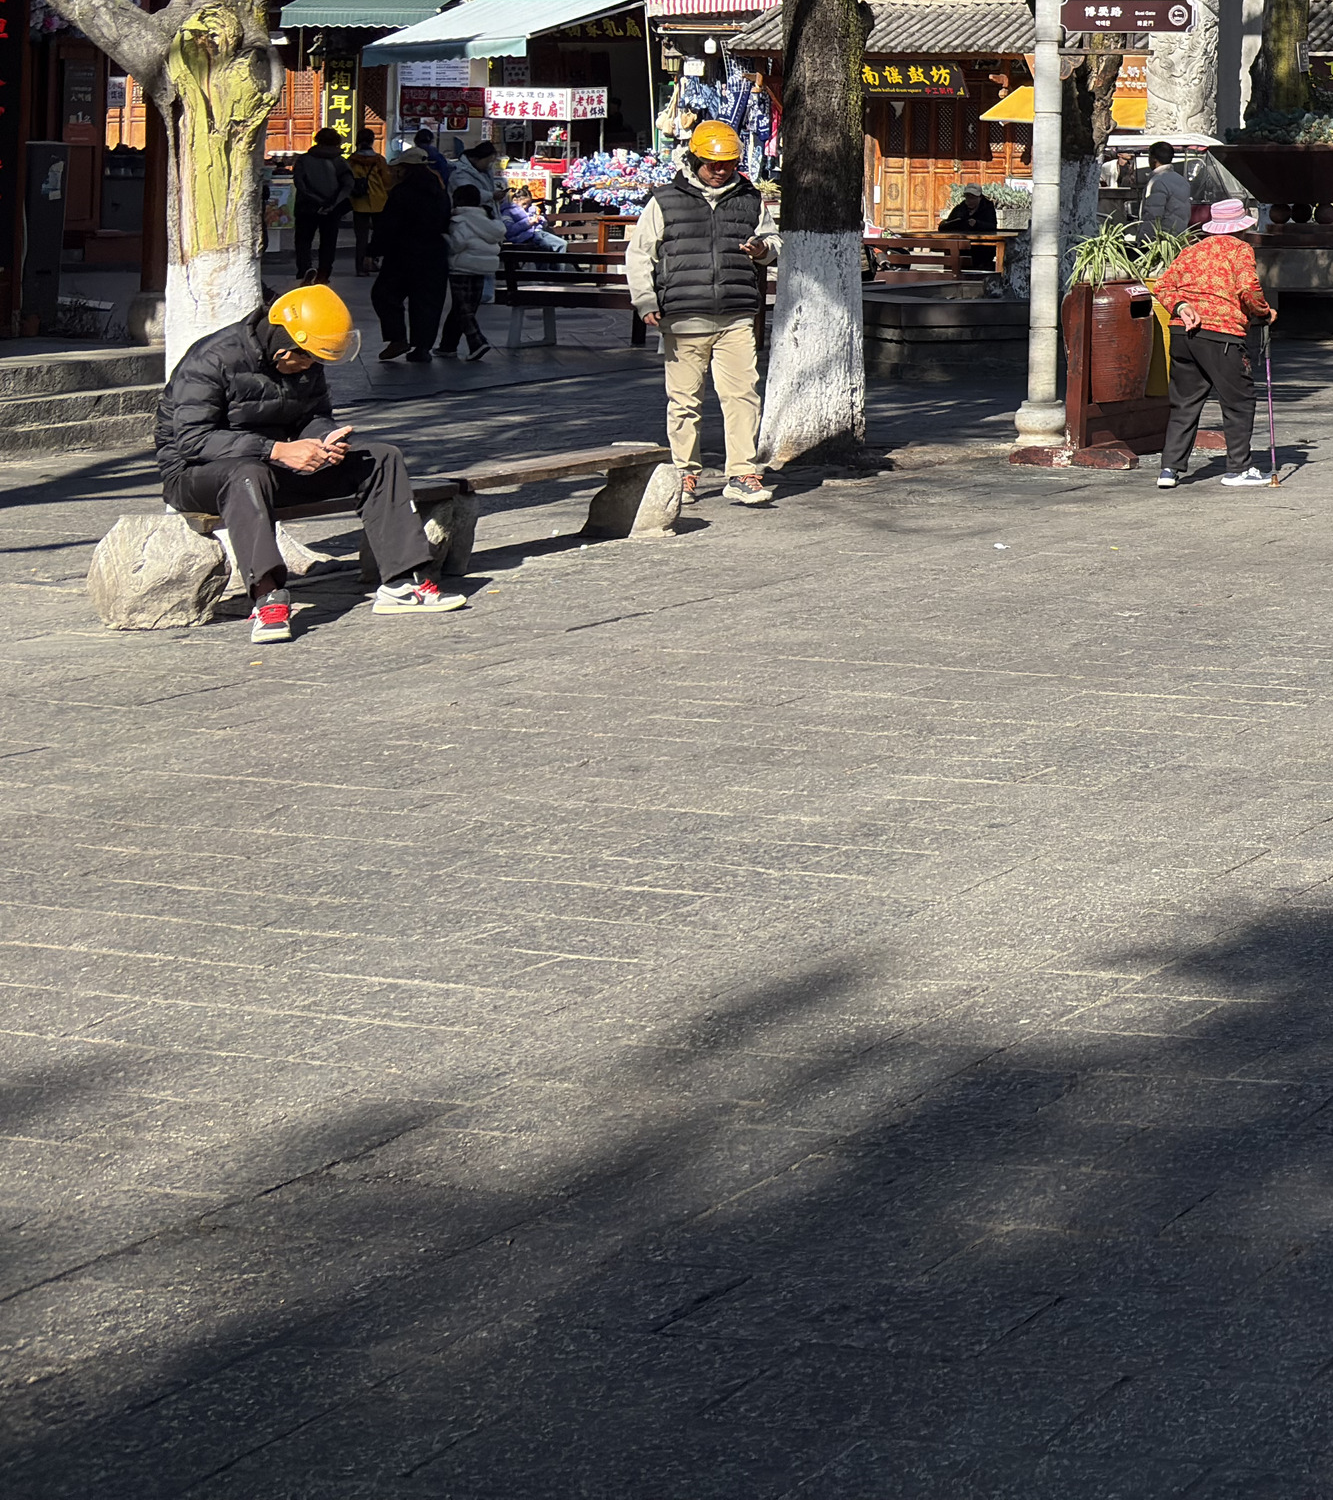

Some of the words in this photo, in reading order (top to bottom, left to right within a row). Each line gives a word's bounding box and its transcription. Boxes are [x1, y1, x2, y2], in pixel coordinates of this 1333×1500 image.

[861, 64, 951, 86] 南谣鼓坊
[488, 100, 558, 118] 老杨家乳扇
[576, 94, 605, 106] 老杨家
